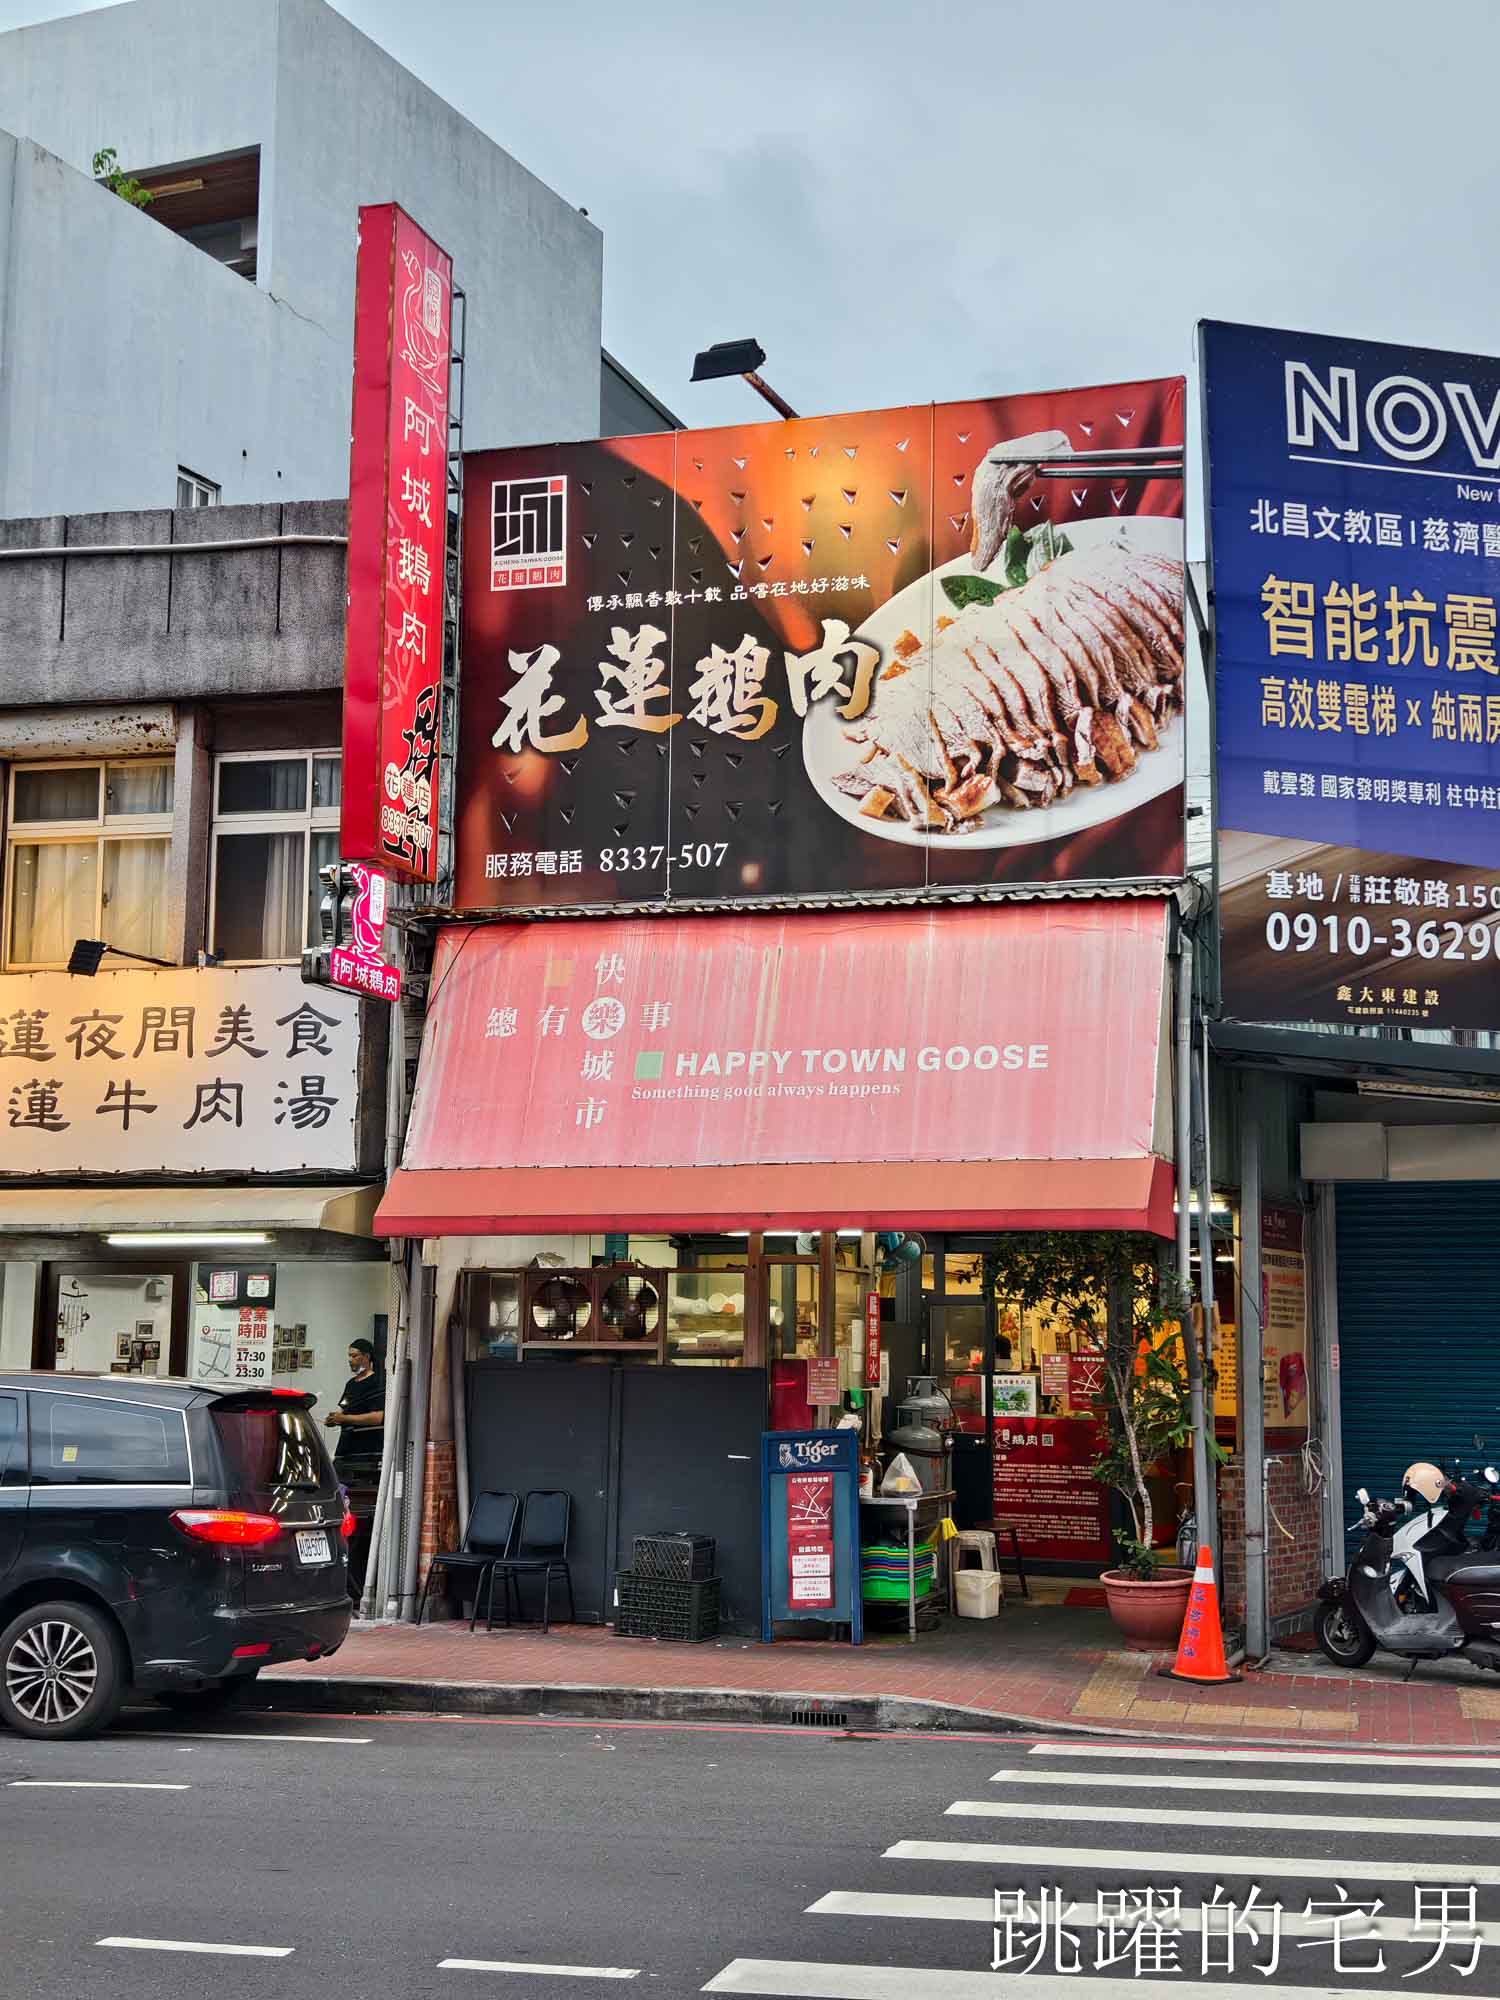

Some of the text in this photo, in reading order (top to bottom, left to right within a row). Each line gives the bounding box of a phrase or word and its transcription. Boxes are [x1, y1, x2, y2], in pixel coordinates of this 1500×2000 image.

[1457, 484, 1493, 503] New
[397, 395, 436, 664] 阿城鵝肉
[1250, 498, 1403, 547] 北昌文教區
[586, 586, 722, 612] 傳承飄香數十載
[1260, 574, 1500, 675] 智能抗震
[491, 618, 881, 754] 花蓮鵝肉
[1260, 676, 1397, 736] 高效雙電梯
[386, 765, 431, 813] 花蓮店
[1263, 770, 1500, 810] 戴雲發 國家發明獎專利 柱中柱
[382, 805, 432, 850] 8337-507
[485, 843, 729, 879] 服務電話 8337-507
[1265, 870, 1324, 901] 基地
[1364, 876, 1449, 909] 莊敬路
[1265, 911, 1500, 961] 0910-3629
[340, 957, 398, 998] 阿城鵝肉
[1336, 984, 1440, 1006] 鑫大東建設
[0, 1002, 342, 1062] 蓮夜間美食
[675, 1044, 1049, 1077] HAPPY TOWN GOOSE
[7, 1075, 340, 1132] 蓮牛肉湯
[631, 1081, 901, 1100] Something good always happens
[238, 1323, 268, 1340] 時間
[239, 1306, 268, 1323] 營業
[235, 1367, 265, 1378] 23:30
[237, 1351, 266, 1362] 17:30
[794, 1440, 839, 1463] Tiger
